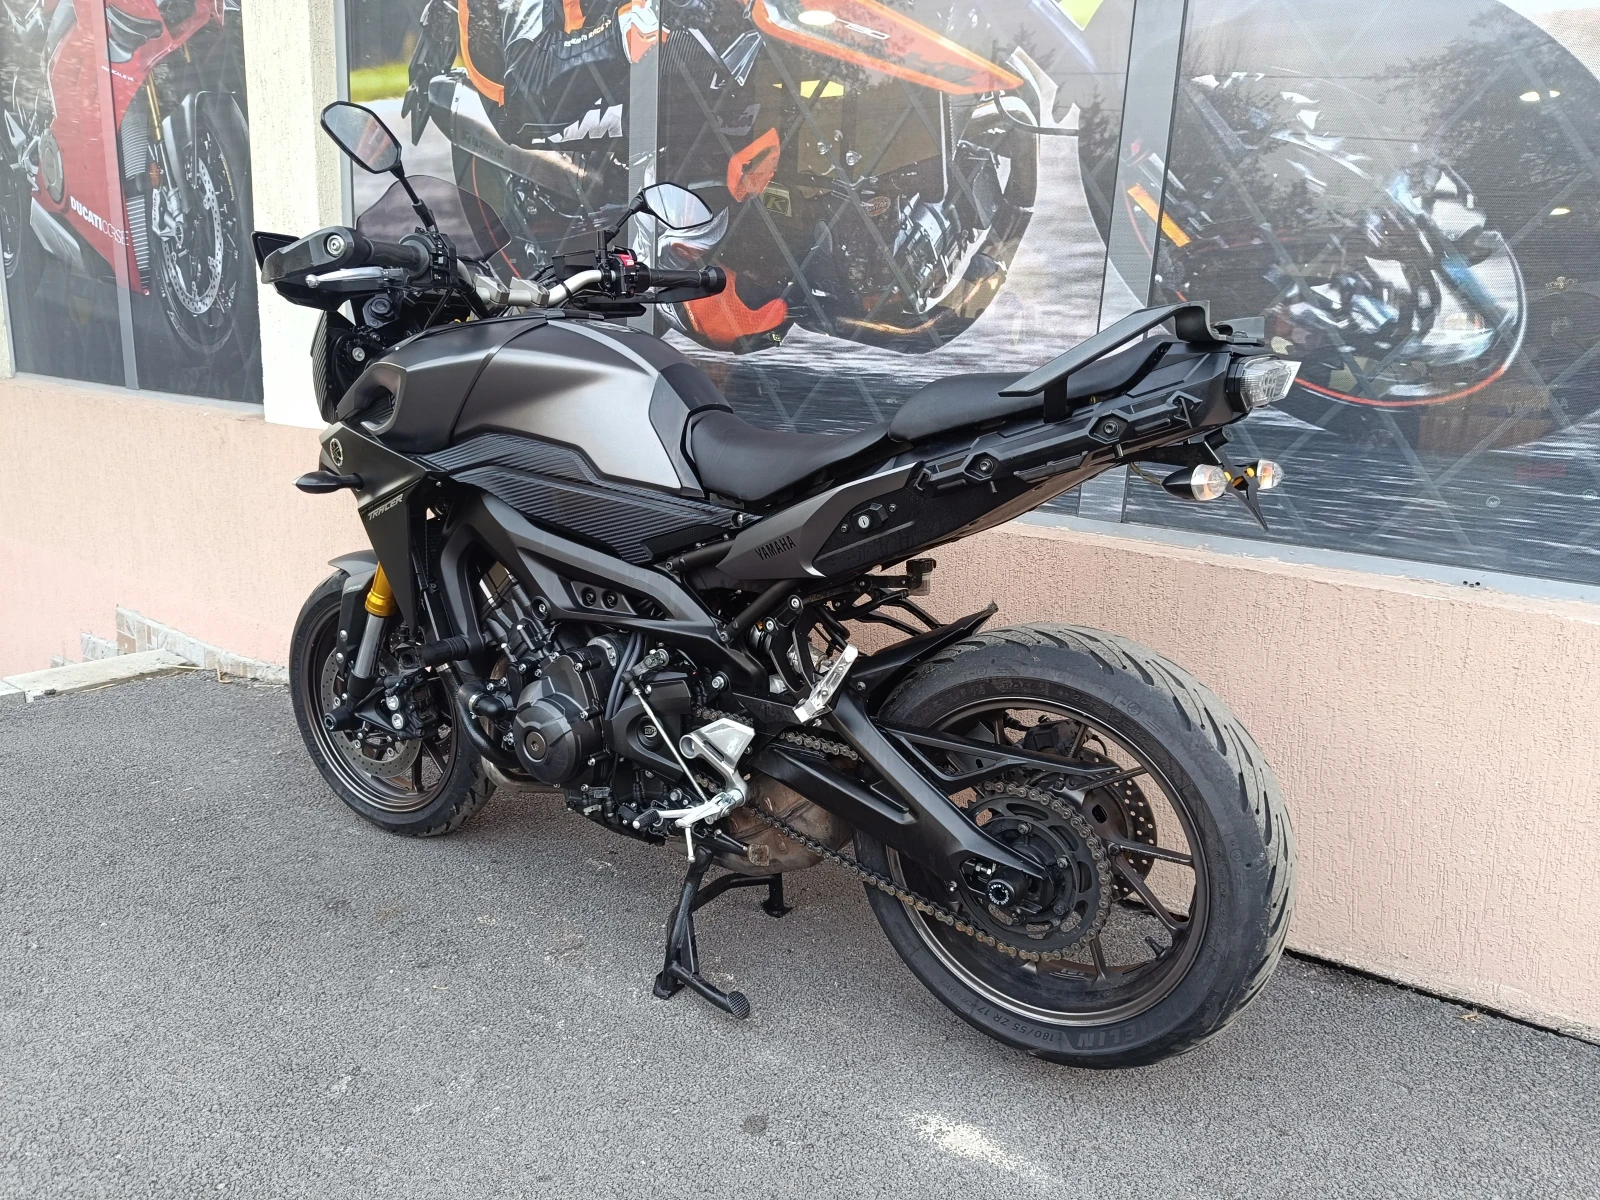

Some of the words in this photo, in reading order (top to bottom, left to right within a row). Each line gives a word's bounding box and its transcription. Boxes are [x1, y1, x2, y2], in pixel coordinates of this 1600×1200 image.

[70, 195, 103, 231] DUCATI
[368, 493, 404, 521] TRACER
[754, 535, 797, 561] YAMAHA
[976, 1005, 991, 1016] 17
[992, 1013, 1011, 1028] ZR
[1011, 1021, 1055, 1043] 180/55
